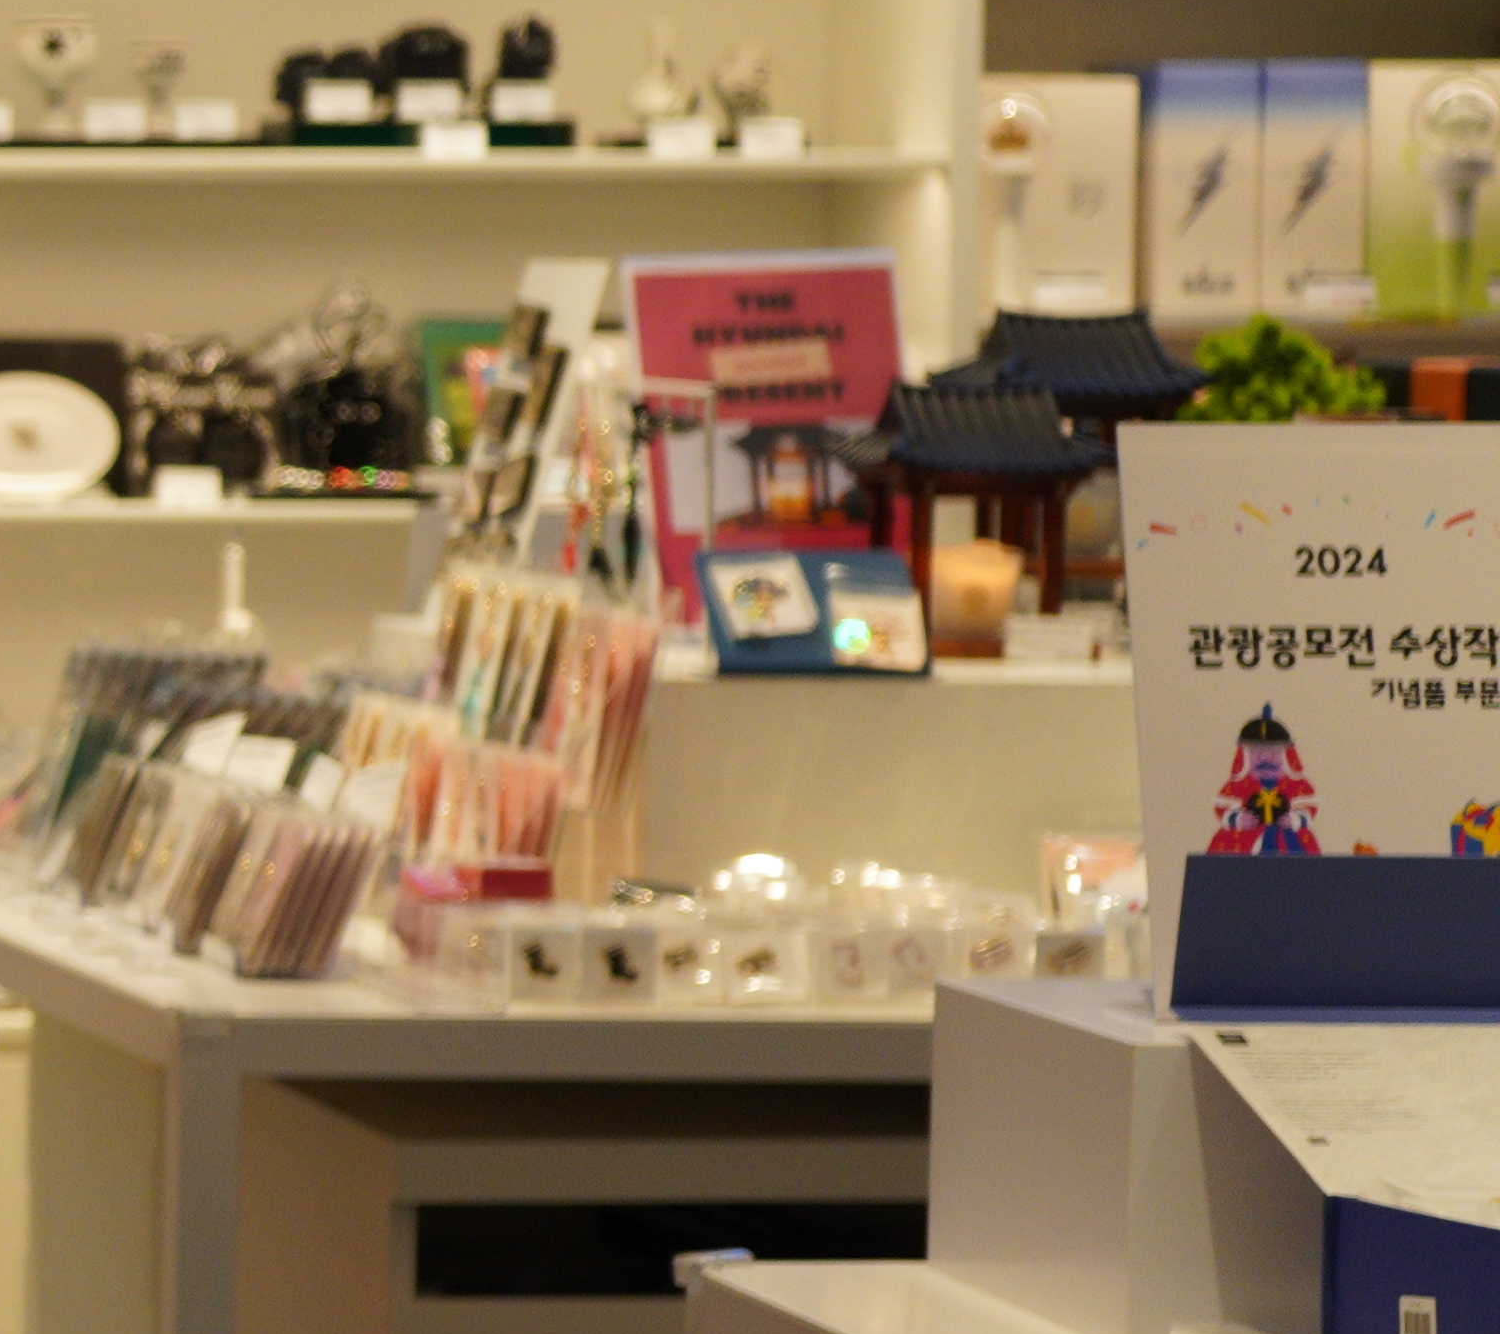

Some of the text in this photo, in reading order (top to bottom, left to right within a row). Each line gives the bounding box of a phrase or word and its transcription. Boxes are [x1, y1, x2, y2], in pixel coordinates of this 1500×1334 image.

[1294, 544, 1389, 577] 2024
[1188, 623, 1500, 670] 관광공모전 수상작
[1370, 678, 1446, 709] 기념품
